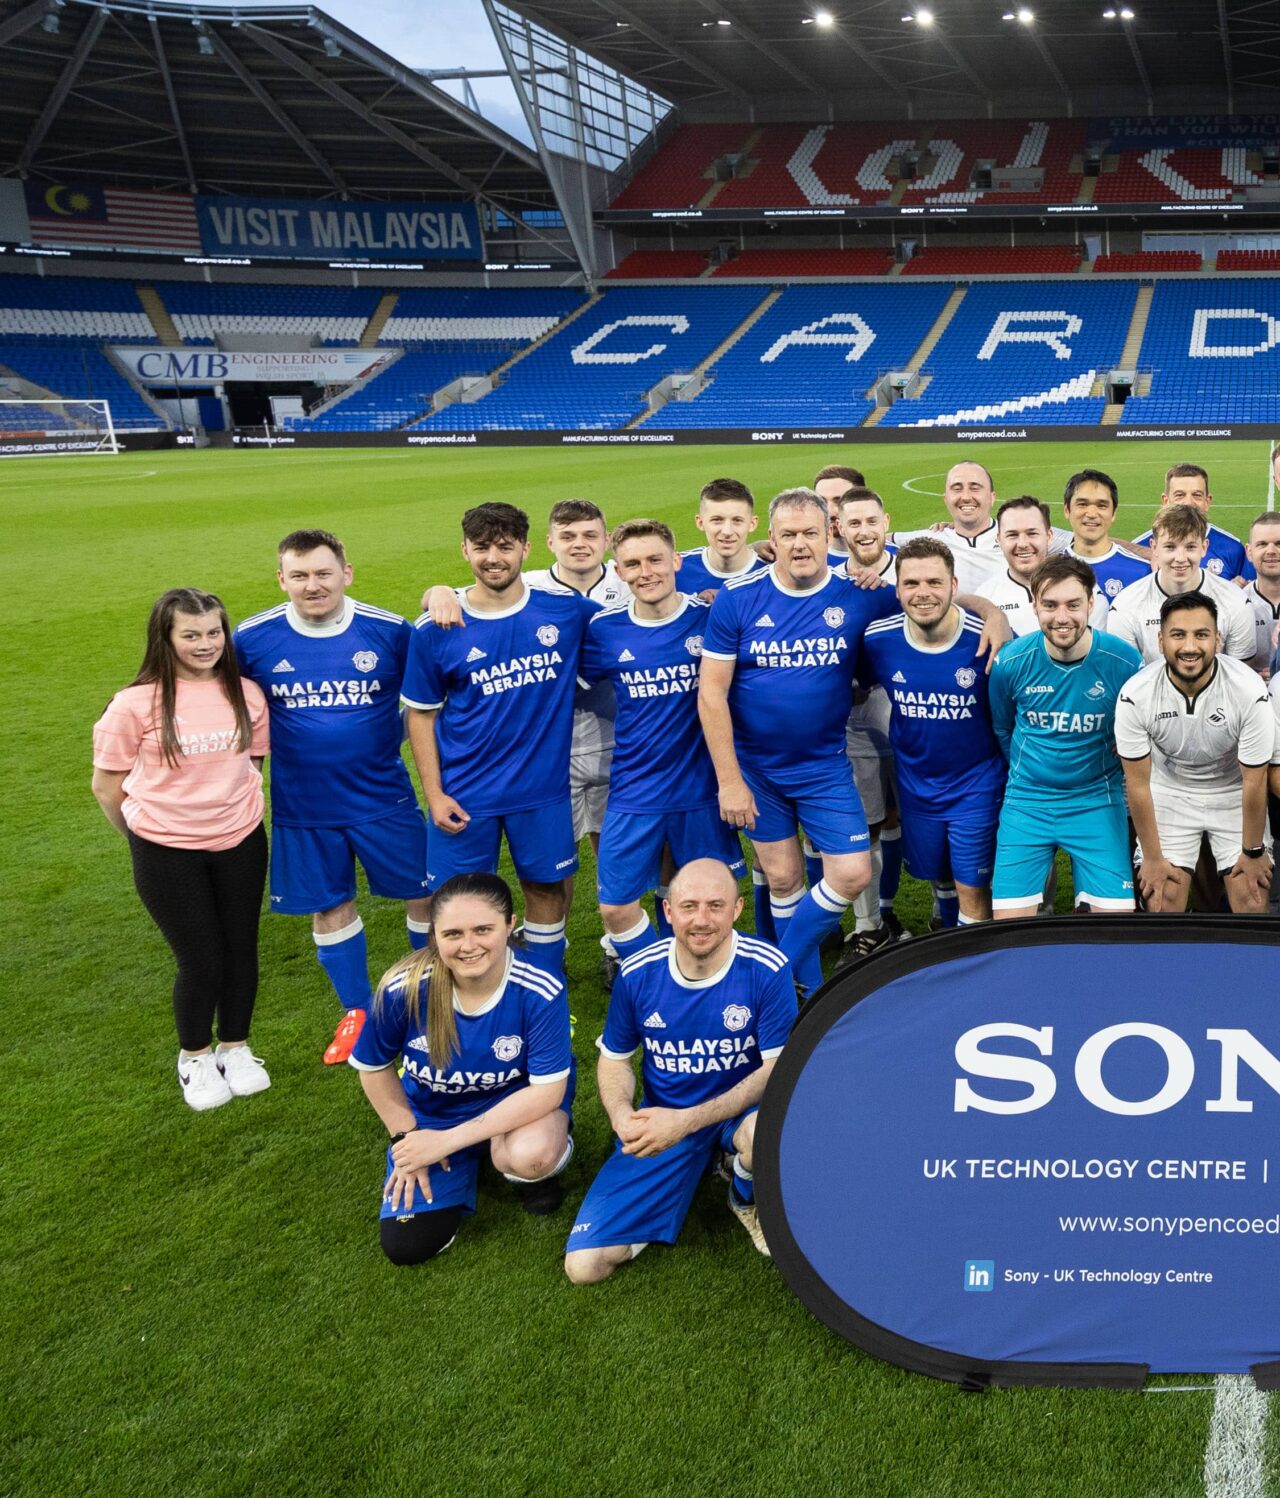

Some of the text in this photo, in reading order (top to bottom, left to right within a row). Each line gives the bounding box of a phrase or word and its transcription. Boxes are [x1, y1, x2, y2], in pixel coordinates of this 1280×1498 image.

[208, 206, 471, 250] VISIT MALAYSIA
[137, 352, 338, 380] CMB ENGINEERING
[407, 434, 477, 445] sonypencoed.co.uk
[562, 435, 609, 443] MANUFACTURING
[639, 434, 675, 442] EXCELLENCE
[751, 432, 785, 441] SONY
[800, 433, 828, 441] Technology
[957, 430, 1027, 440] sonypencoed.co.uk
[1196, 429, 1232, 437] EXCELLENCE
[750, 636, 848, 656] MALAYSIA
[470, 650, 563, 685] MALAYSIA
[756, 652, 841, 668] BERJAYA
[481, 666, 557, 696] BERJAYA
[619, 663, 701, 685] MALAYSI
[270, 679, 381, 697] MALAYSIA
[1025, 684, 1055, 695] Joma
[283, 693, 374, 709] BERJAYA
[893, 689, 977, 707] MALAYSIA
[899, 703, 973, 721] BERJAYA
[645, 1035, 757, 1056] MALAYSIA
[403, 1054, 522, 1086] MALAYSIA
[653, 1052, 750, 1074] BERJAYA
[923, 1159, 958, 1179] UK
[965, 1158, 1139, 1180] TECHNOLOGY
[1146, 1159, 1247, 1180] CENTRE
[1004, 1268, 1213, 1285] Sony UK Technology Centre
